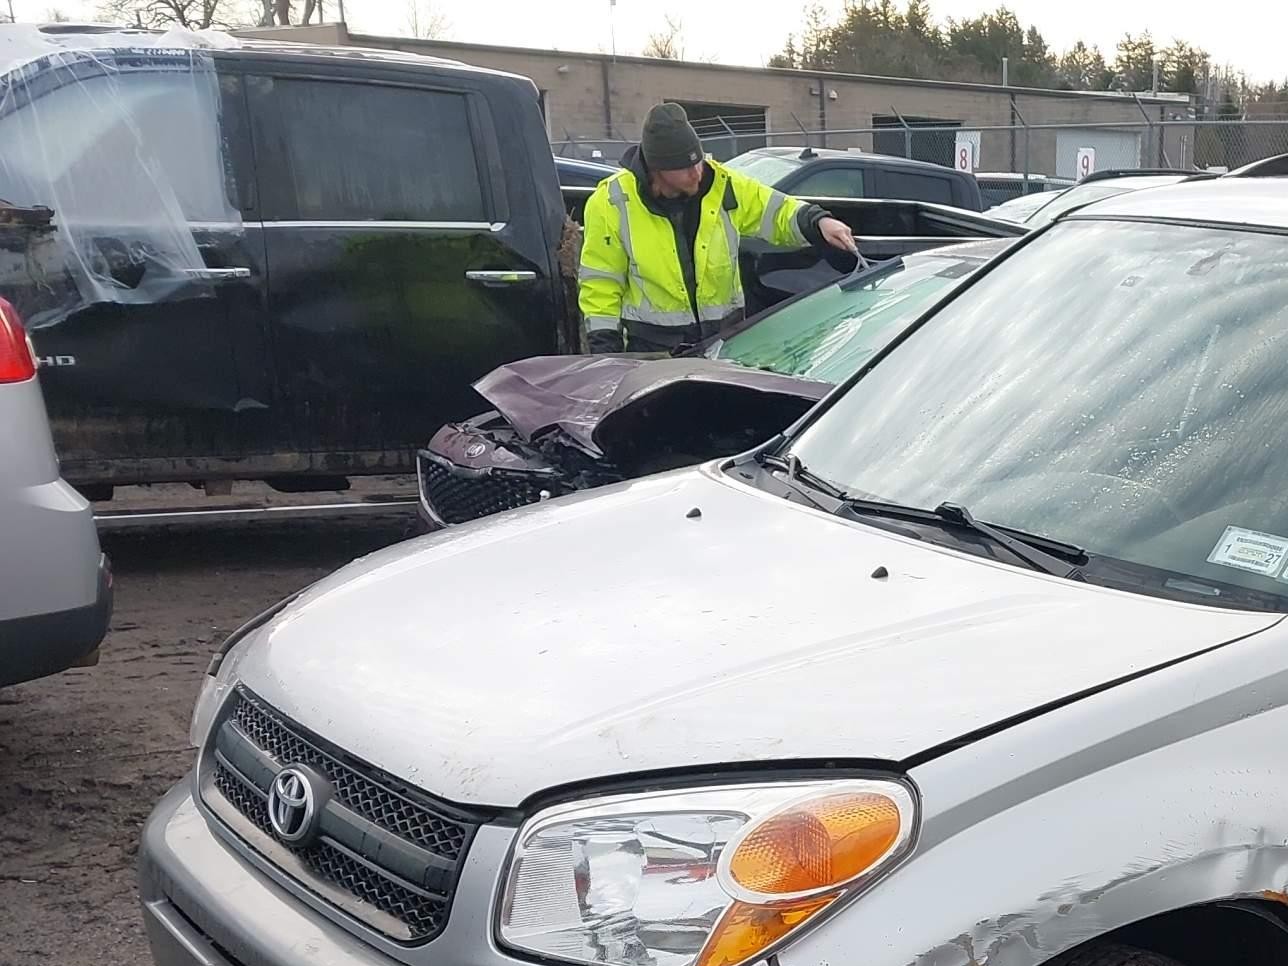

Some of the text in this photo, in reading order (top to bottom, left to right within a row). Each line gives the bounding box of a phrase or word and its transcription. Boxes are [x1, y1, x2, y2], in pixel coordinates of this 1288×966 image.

[960, 148, 968, 170] 8
[1081, 155, 1090, 177] 9
[1264, 553, 1282, 565] 27
